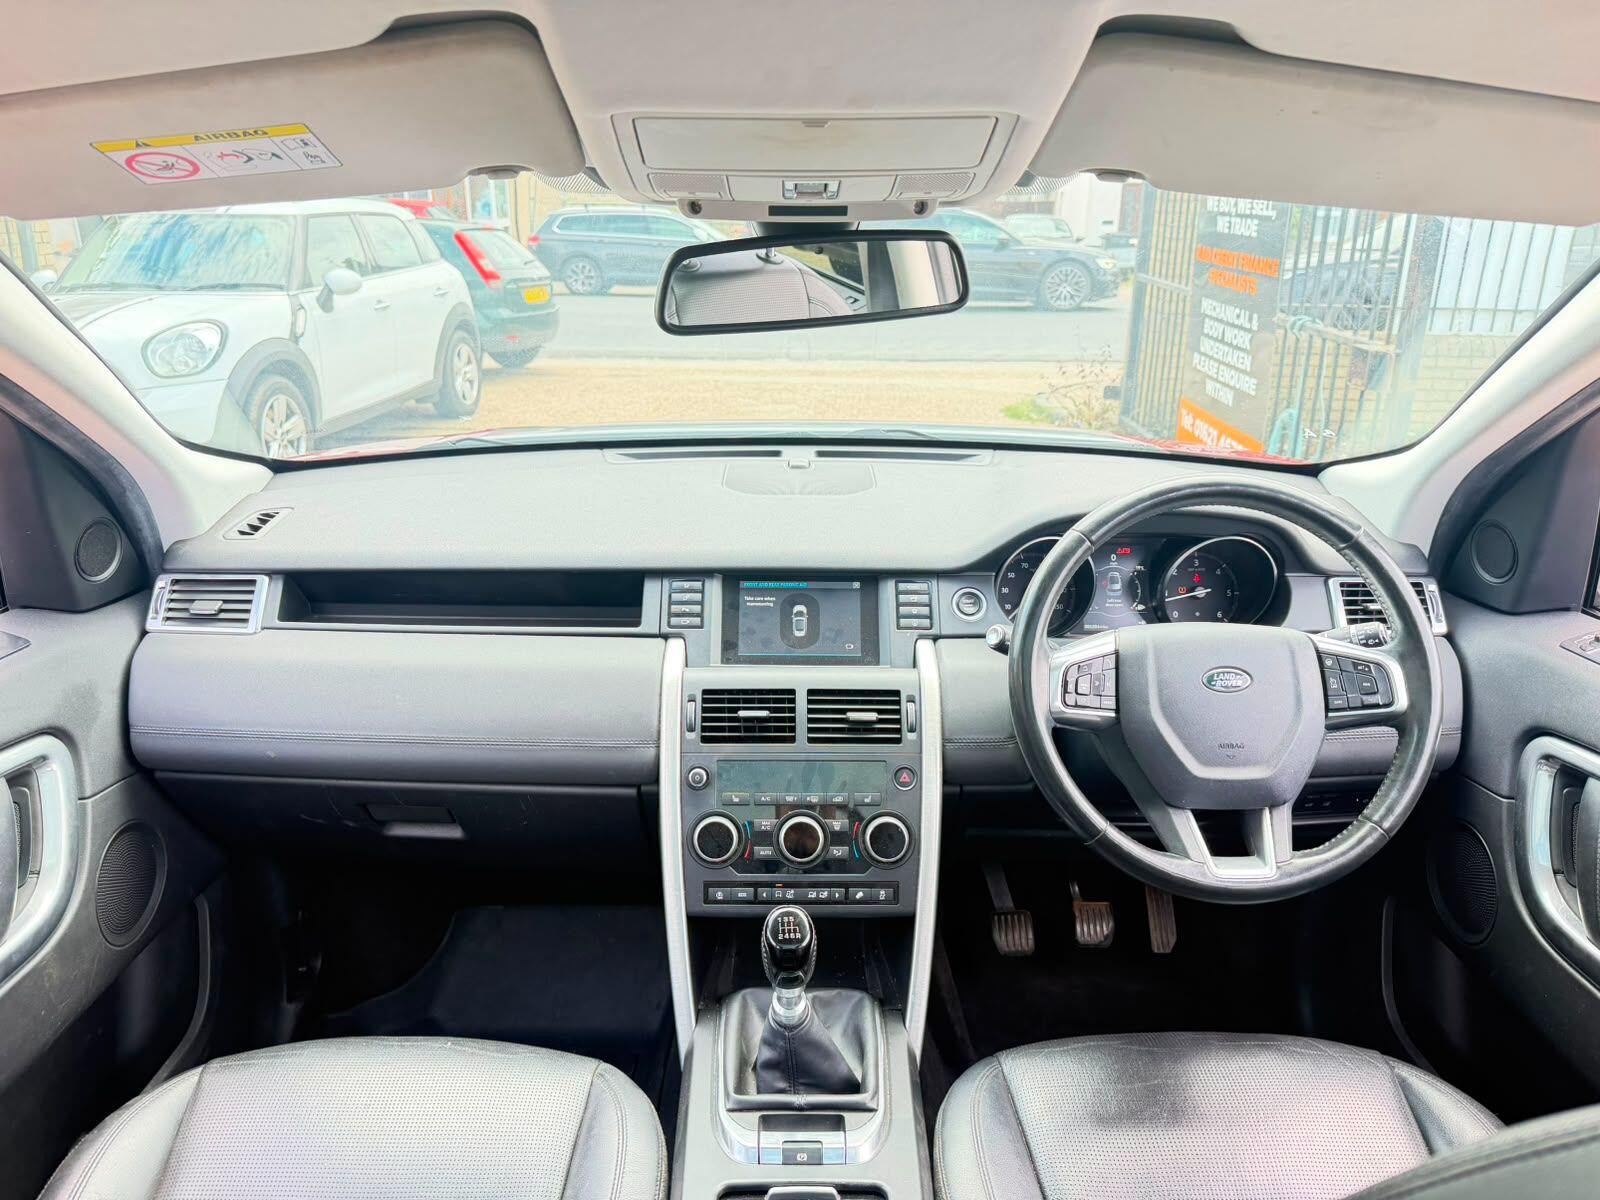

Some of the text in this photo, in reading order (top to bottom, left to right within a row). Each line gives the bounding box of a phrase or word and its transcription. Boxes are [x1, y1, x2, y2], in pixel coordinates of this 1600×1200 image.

[193, 129, 269, 143] AIRBAG
[1206, 197, 1219, 212] WE
[1237, 199, 1251, 214] WE
[1216, 215, 1259, 237] WE TRADE
[1239, 252, 1280, 278] FINANCE
[1201, 296, 1259, 332] MECHANICAL &
[1203, 317, 1252, 350] BODY WORK
[1200, 336, 1252, 372] UNDERTAKEN
[1192, 351, 1258, 397] PLEASE ENQUIRE
[1205, 378, 1234, 408] WITHIN
[1215, 680, 1243, 688] ROVER
[1217, 742, 1245, 750] AIRBAG
